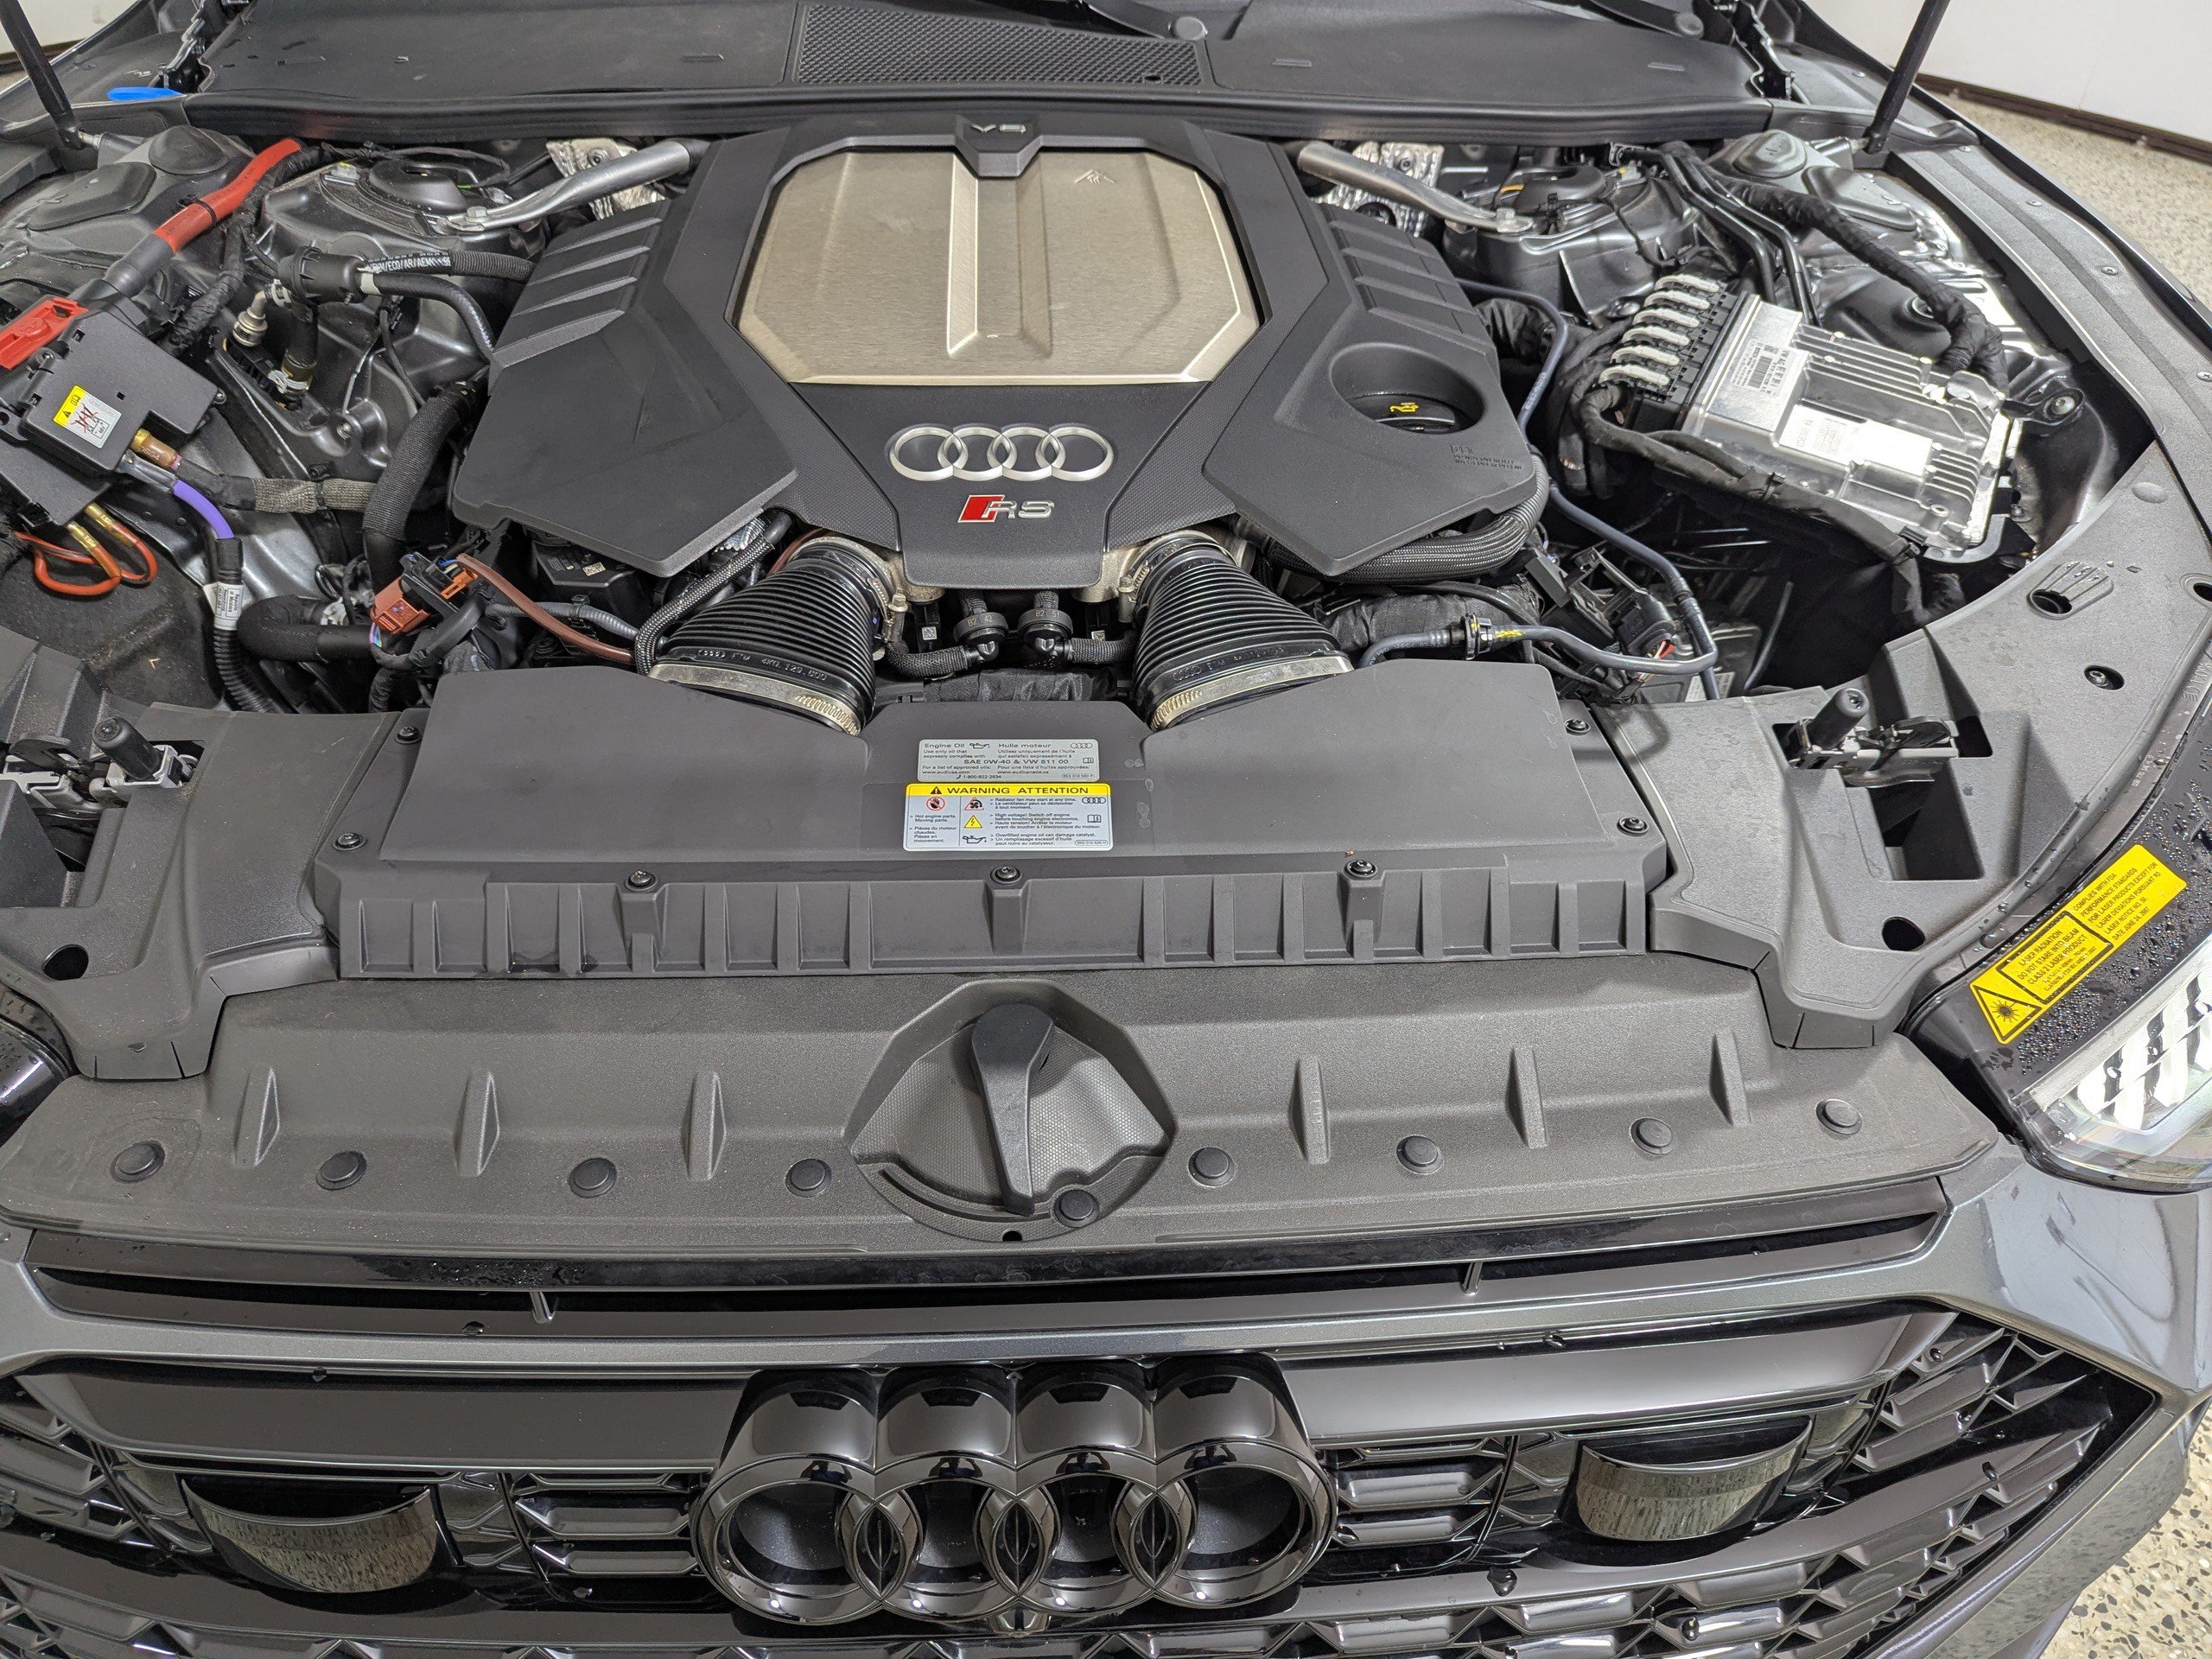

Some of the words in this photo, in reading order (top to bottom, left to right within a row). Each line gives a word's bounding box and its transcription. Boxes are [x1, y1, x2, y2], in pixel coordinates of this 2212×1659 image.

[982, 500, 1054, 518] RS
[2073, 889, 2097, 911] COMPLIES
[2094, 880, 2108, 891] WITH
[2106, 873, 2116, 881] FDA
[2080, 887, 2114, 917] PERFORMANCE
[2112, 867, 2137, 888] STANDARDS
[2088, 912, 2101, 922] FOR
[2098, 899, 2113, 913] LASER
[2112, 881, 2135, 901] PRODUCTS
[2133, 868, 2149, 883] EXCEPT
[2147, 861, 2157, 870] FOR
[2095, 913, 2113, 928] LASER
[2110, 893, 2135, 915] DEVIATIONS
[2133, 876, 2155, 896] PURSUANT
[2104, 920, 2120, 933] LASER
[2118, 907, 2134, 922] NOTICE
[2112, 928, 2125, 939] DATE
[2123, 918, 2135, 931] JUNE
[2139, 906, 2150, 916] 2007
[2017, 970, 2027, 979] DO
[2024, 963, 2037, 973] NOT
[2035, 950, 2053, 964] STARE
[2050, 939, 2064, 952] INTO
[2063, 927, 2079, 942] BEAM
[2018, 951, 2036, 966] LASER
[2033, 929, 2063, 953] RADIATION
[2027, 969, 2045, 984] CLASS
[2046, 953, 2064, 968] LASER
[2062, 933, 2087, 955] PRODUCT
